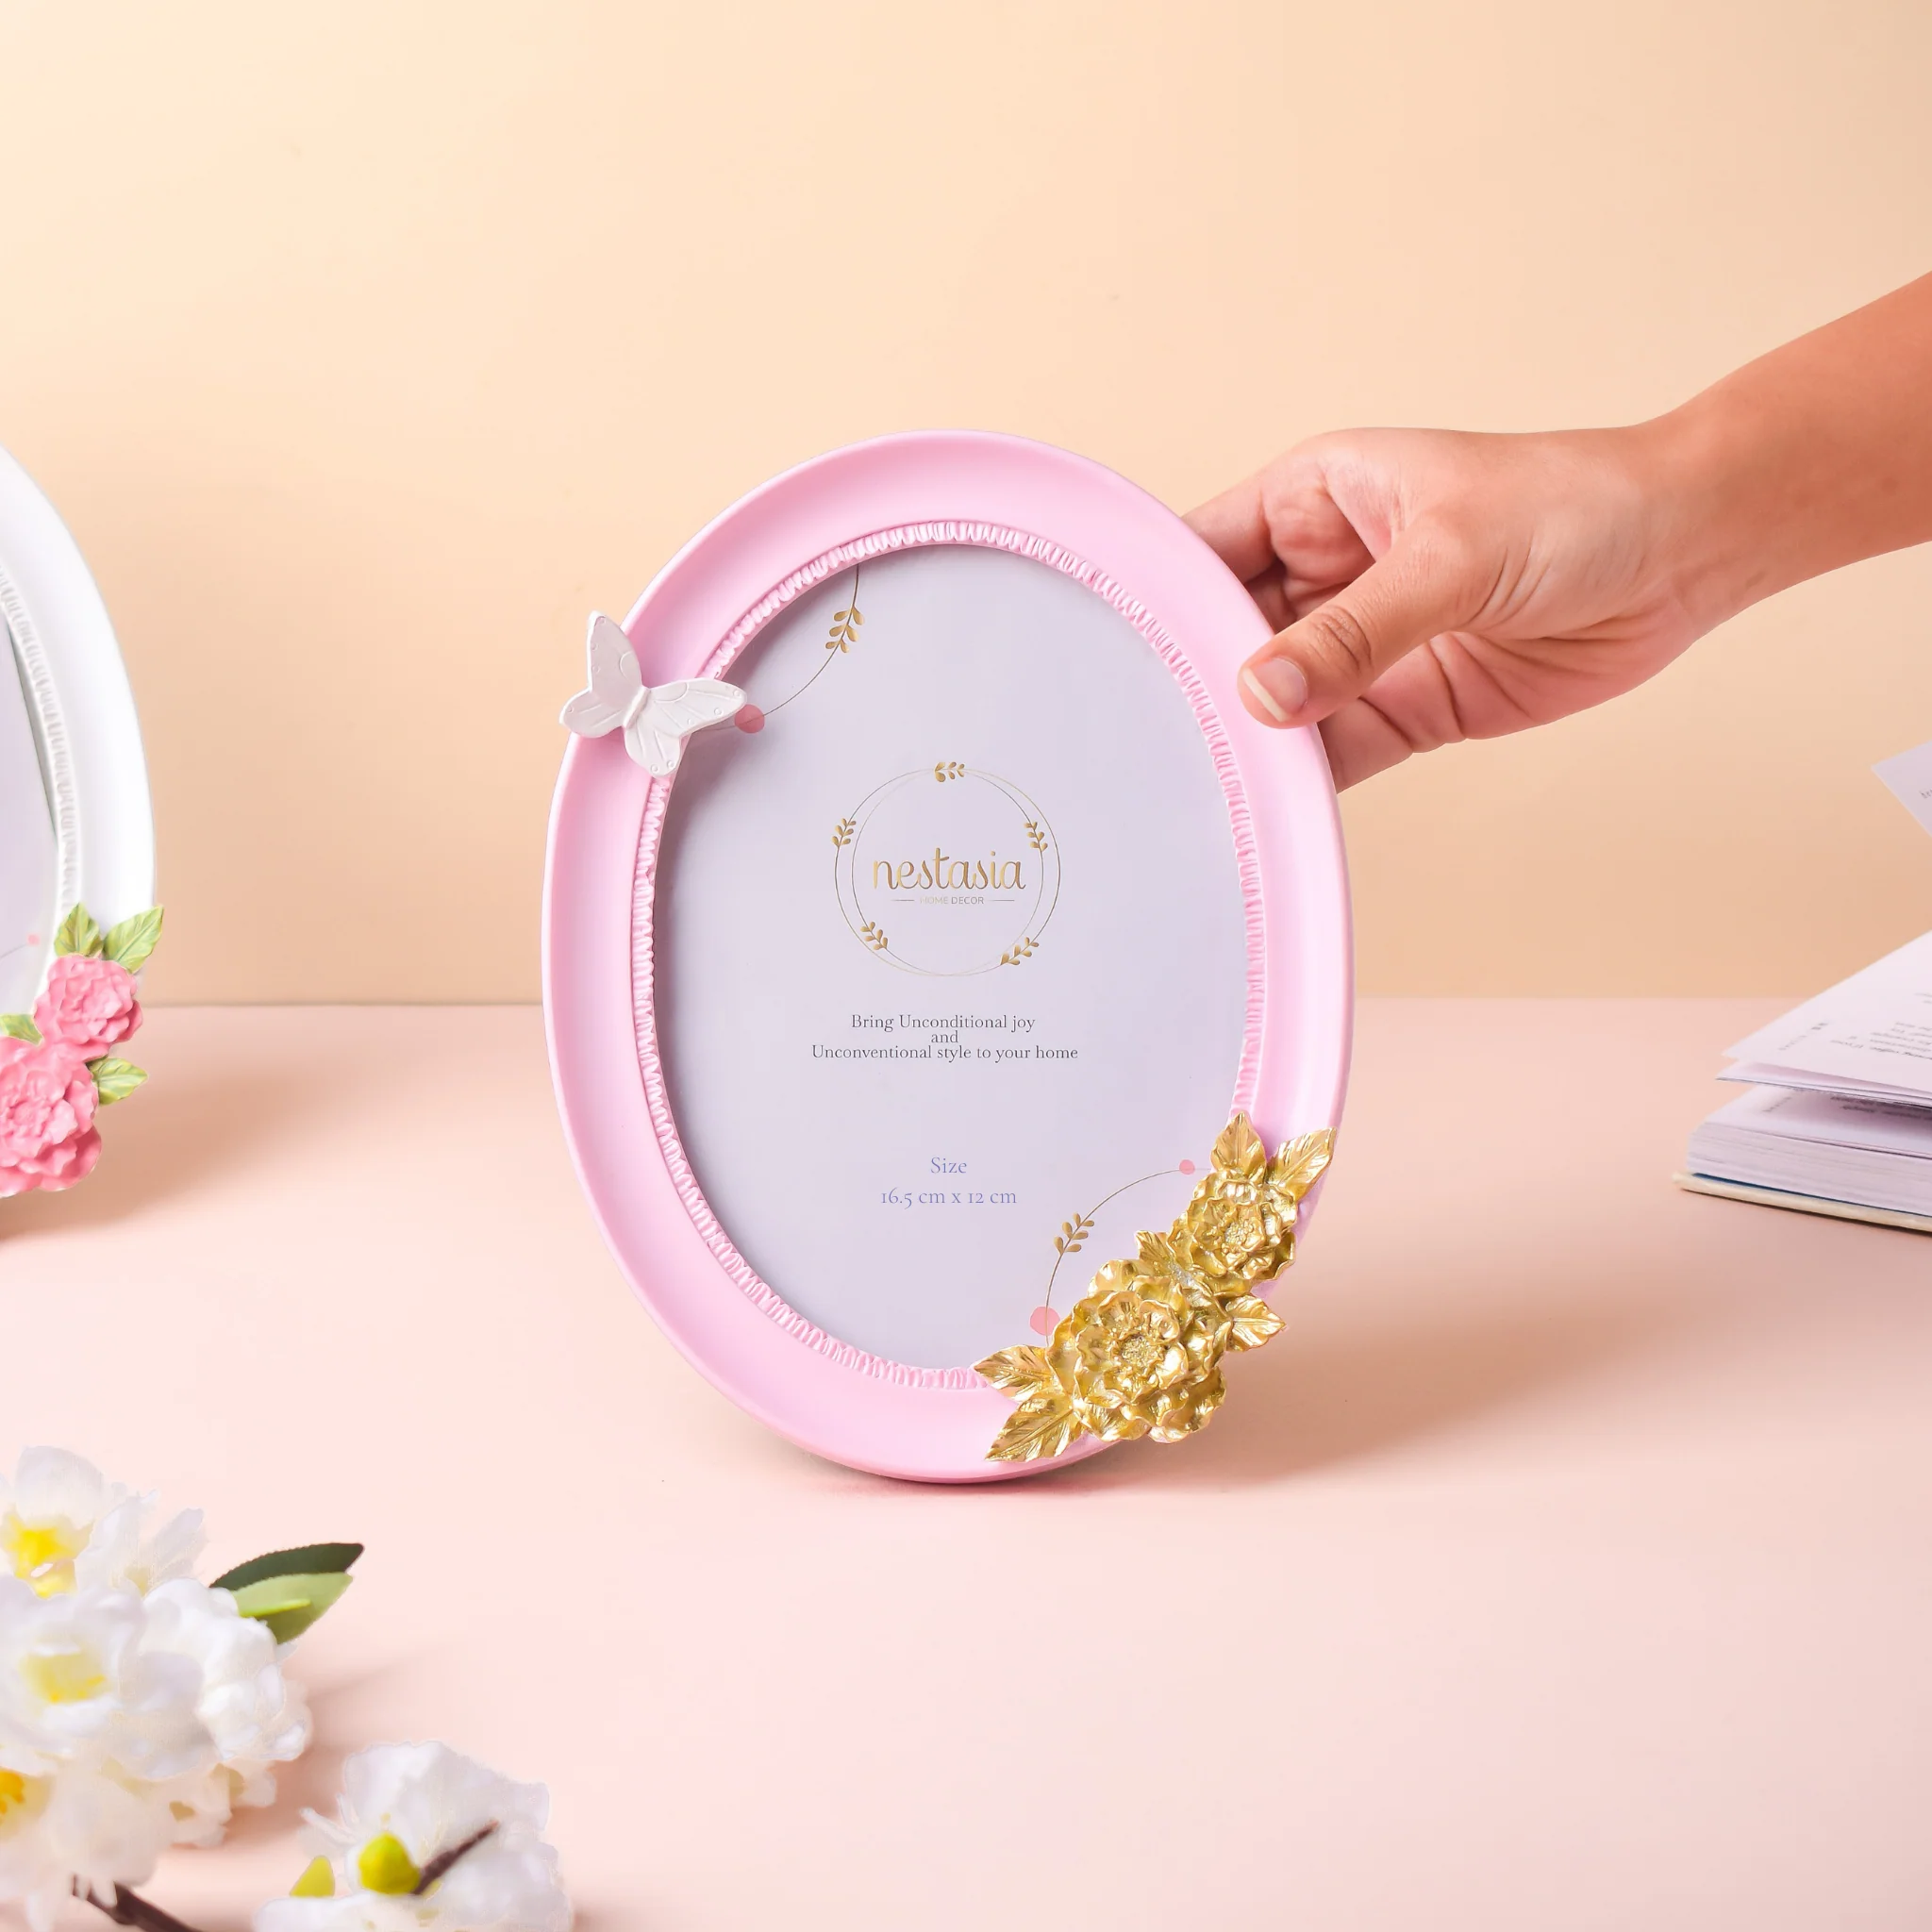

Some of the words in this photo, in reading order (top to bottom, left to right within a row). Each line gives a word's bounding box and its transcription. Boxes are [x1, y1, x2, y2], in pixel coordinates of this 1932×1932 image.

[873, 847, 1026, 890] nestasia
[920, 896, 948, 905] HOME
[951, 896, 984, 905] DECOR
[851, 1014, 894, 1032] Bring
[899, 1014, 1008, 1028] Unconditional
[1011, 1015, 1036, 1033] joy
[930, 1030, 958, 1043] and
[812, 1044, 932, 1058] Unconventional
[937, 1044, 972, 1063] style
[976, 1048, 991, 1058] to
[994, 1048, 1031, 1063] your
[1036, 1044, 1078, 1058] home
[930, 1157, 968, 1174] Size
[881, 1186, 912, 1210] 16.5
[918, 1192, 945, 1204] cm
[951, 1192, 962, 1204] x
[968, 1192, 985, 1204] 12
[990, 1192, 1017, 1204] cm
